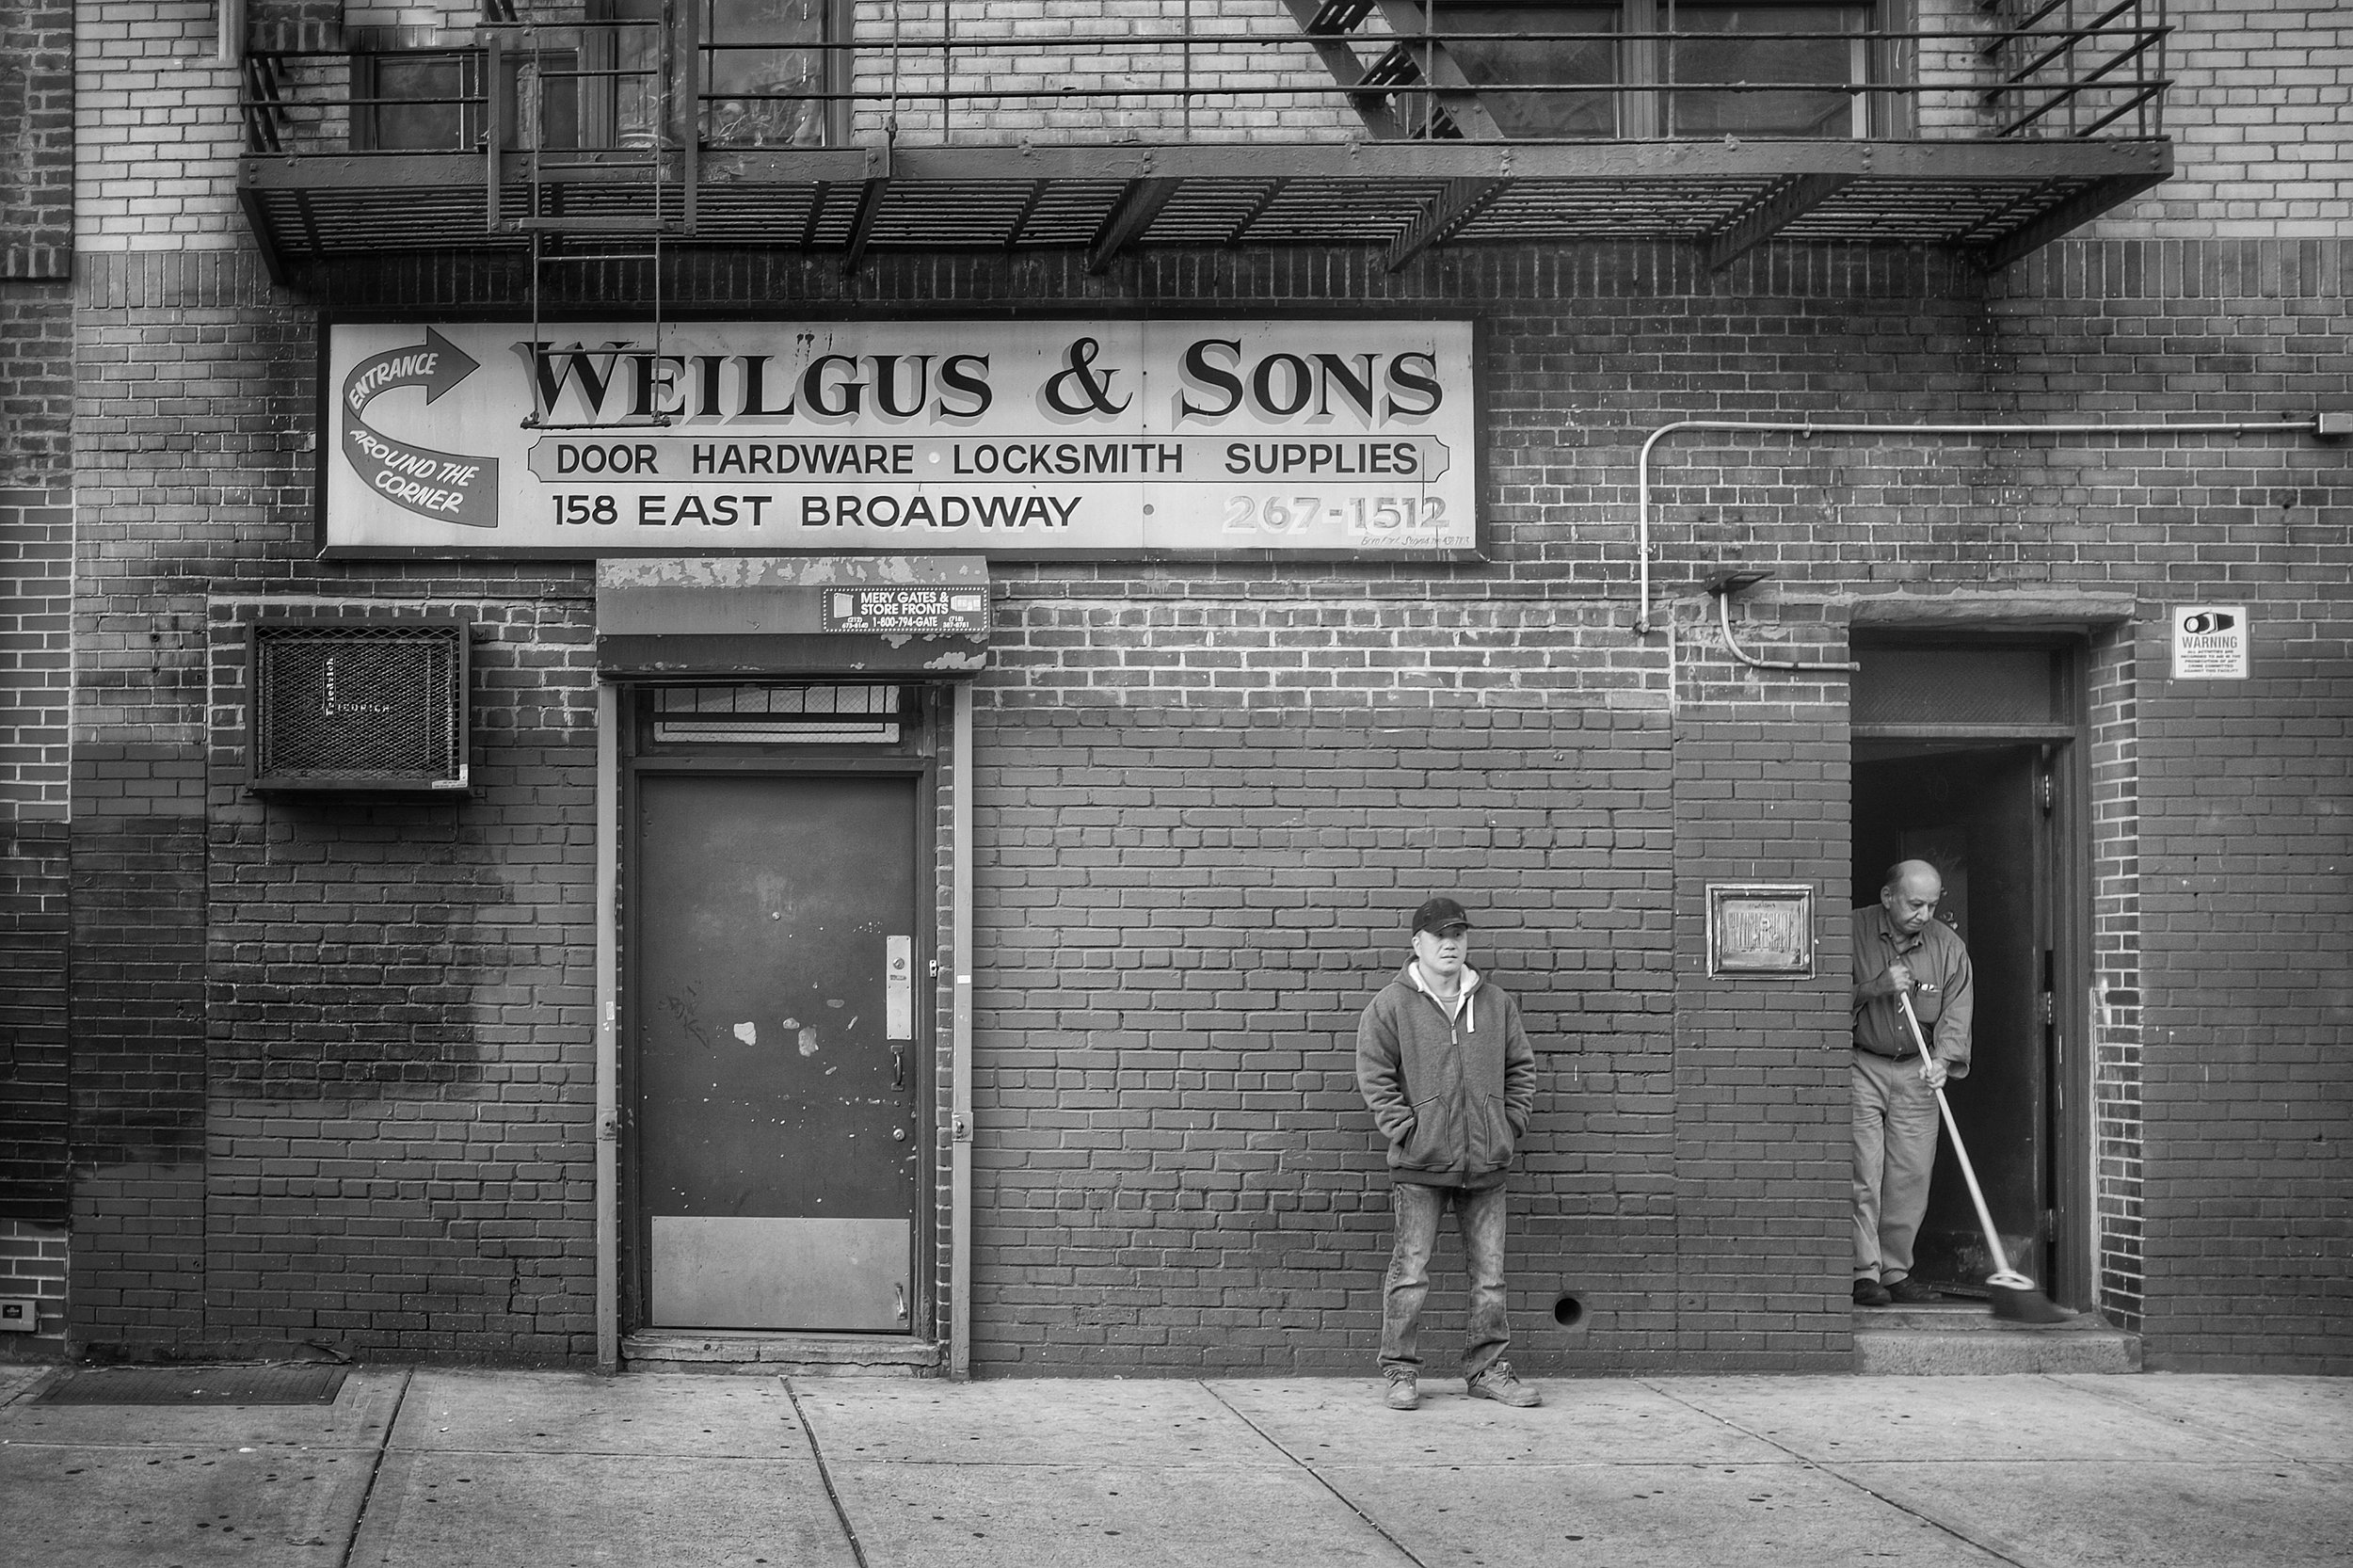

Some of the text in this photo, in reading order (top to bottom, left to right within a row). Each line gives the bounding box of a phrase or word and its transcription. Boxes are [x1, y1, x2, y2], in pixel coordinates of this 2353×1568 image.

[348, 353, 440, 410] ENTRANCE
[512, 337, 1443, 423] WEILGUS & SONS
[349, 429, 480, 487] AROUND THE
[556, 442, 1418, 475] DOOR HARDWARE LOCKSMITH SUPPLIES
[375, 470, 464, 514] CORNER
[552, 494, 1083, 528] 158 EAST BROADWAY
[1227, 495, 1450, 529] 267-1512
[860, 592, 950, 603] MERY GATES &
[860, 603, 950, 616] STORE FRONTS
[872, 616, 938, 628] 1-800-794-GATE
[2182, 636, 2238, 648] WARNING
